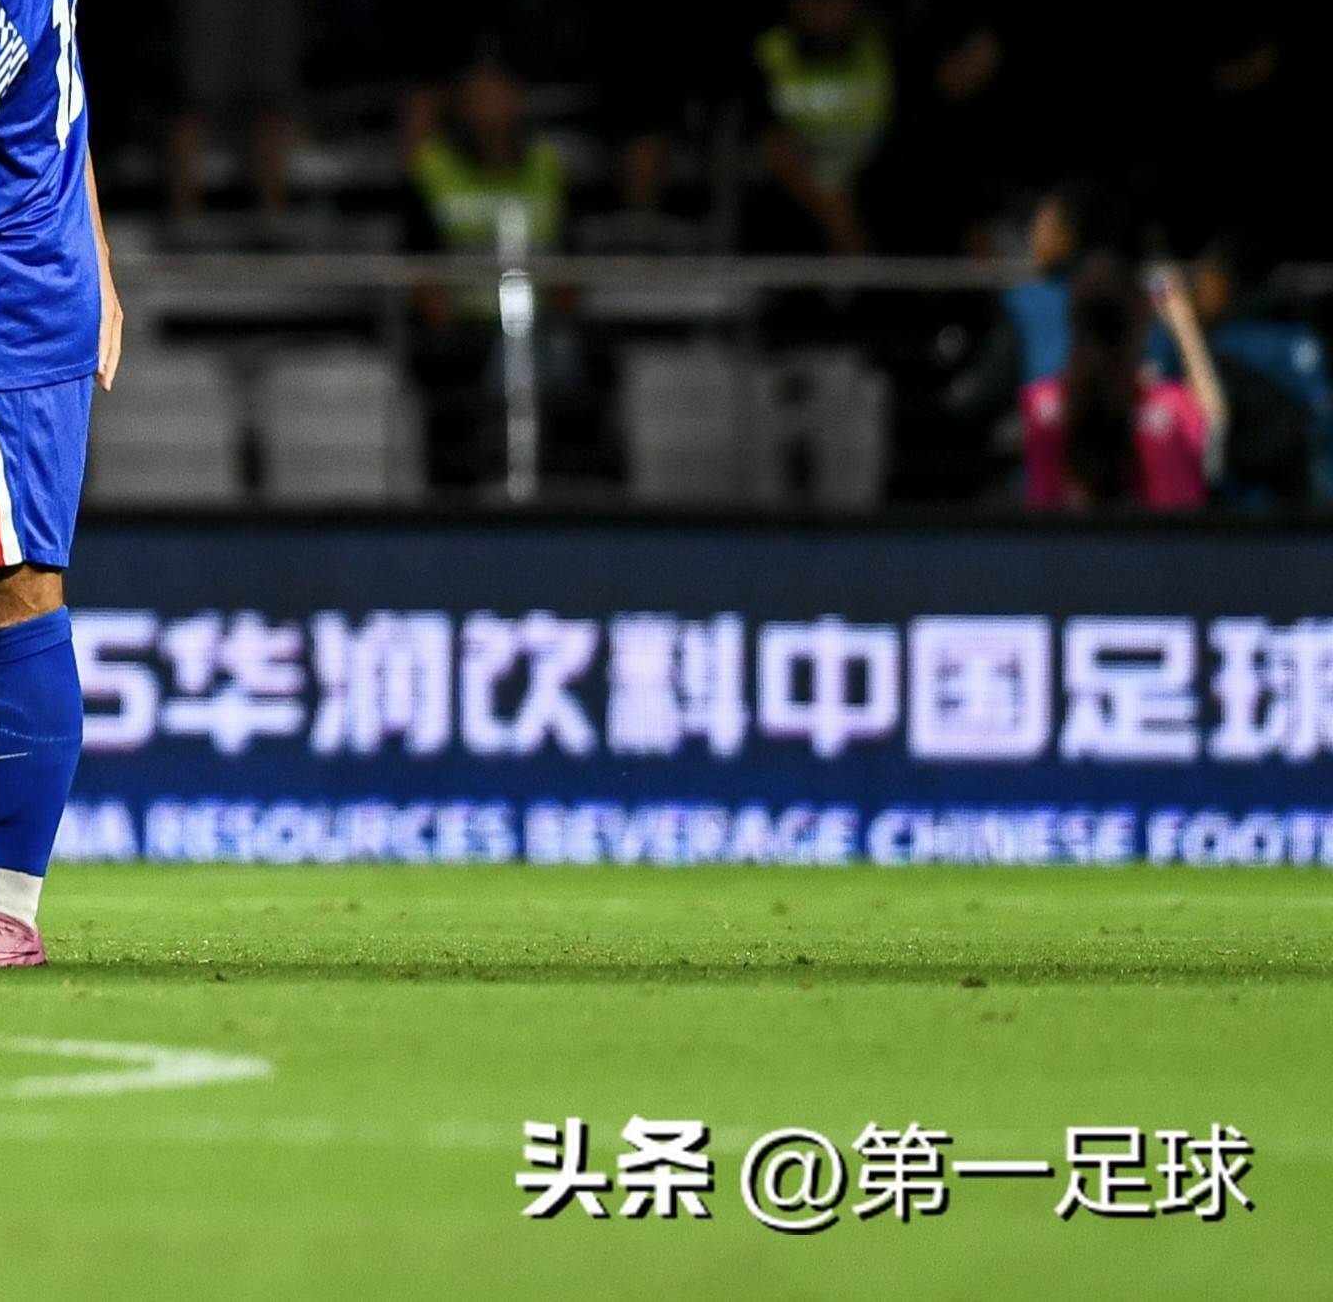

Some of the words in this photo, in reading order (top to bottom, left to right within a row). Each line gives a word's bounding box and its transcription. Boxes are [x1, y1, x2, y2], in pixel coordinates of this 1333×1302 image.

[144, 801, 517, 861] RESOURCES
[525, 805, 859, 865] BEVERAGE
[867, 807, 1132, 866] CHINESE
